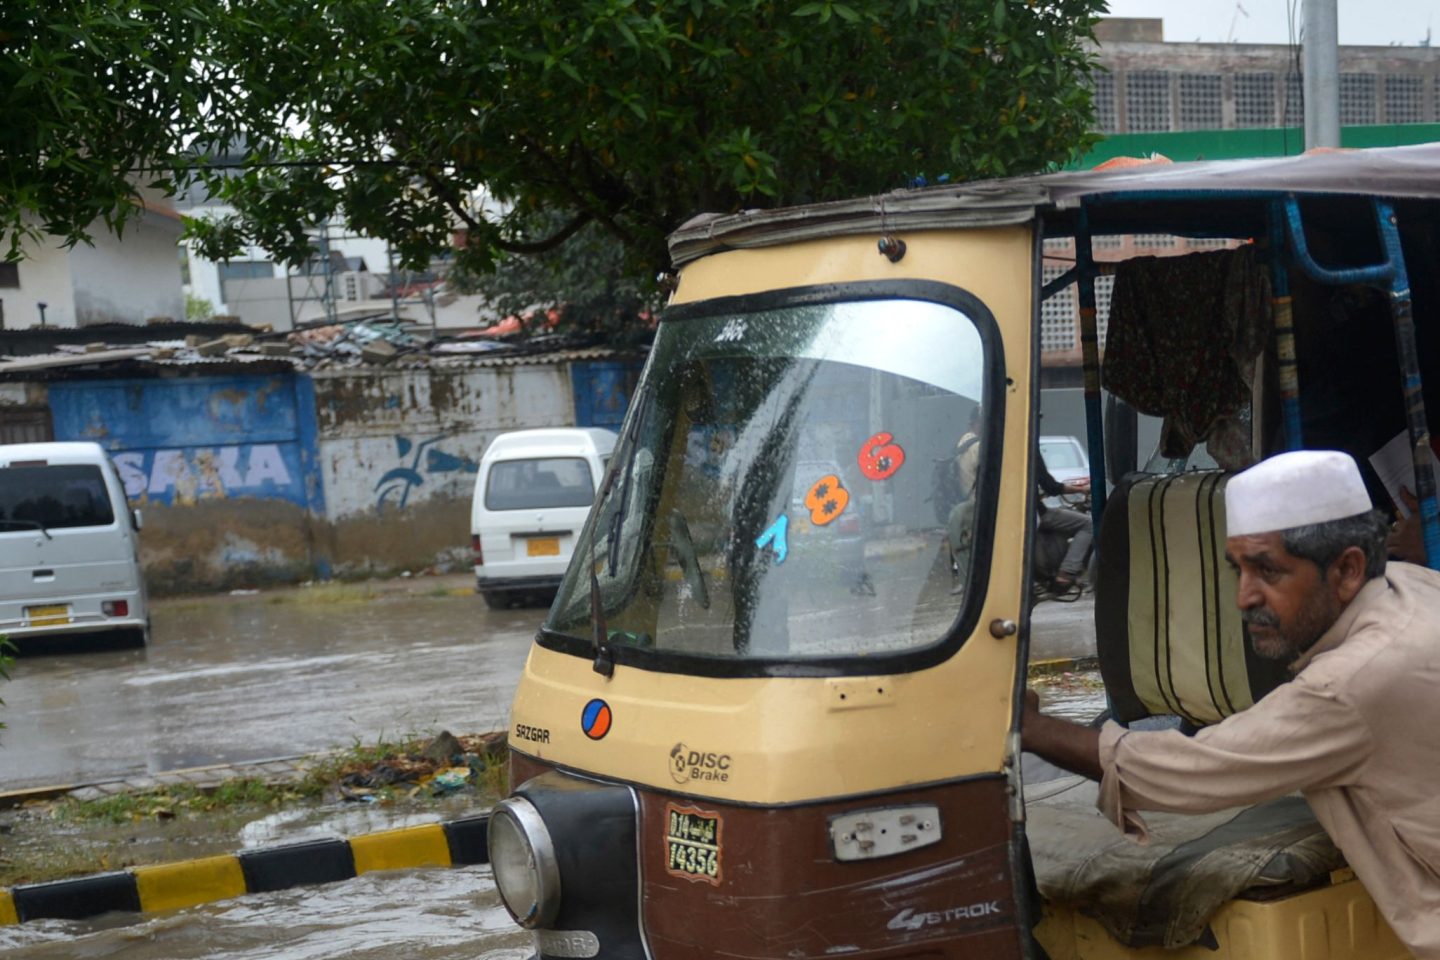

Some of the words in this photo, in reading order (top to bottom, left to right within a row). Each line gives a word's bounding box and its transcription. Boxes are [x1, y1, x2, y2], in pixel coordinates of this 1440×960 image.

[516, 723, 551, 745] SAZGAR
[687, 751, 731, 770] DISC
[691, 767, 729, 782] Brake
[669, 843, 718, 877] 14356
